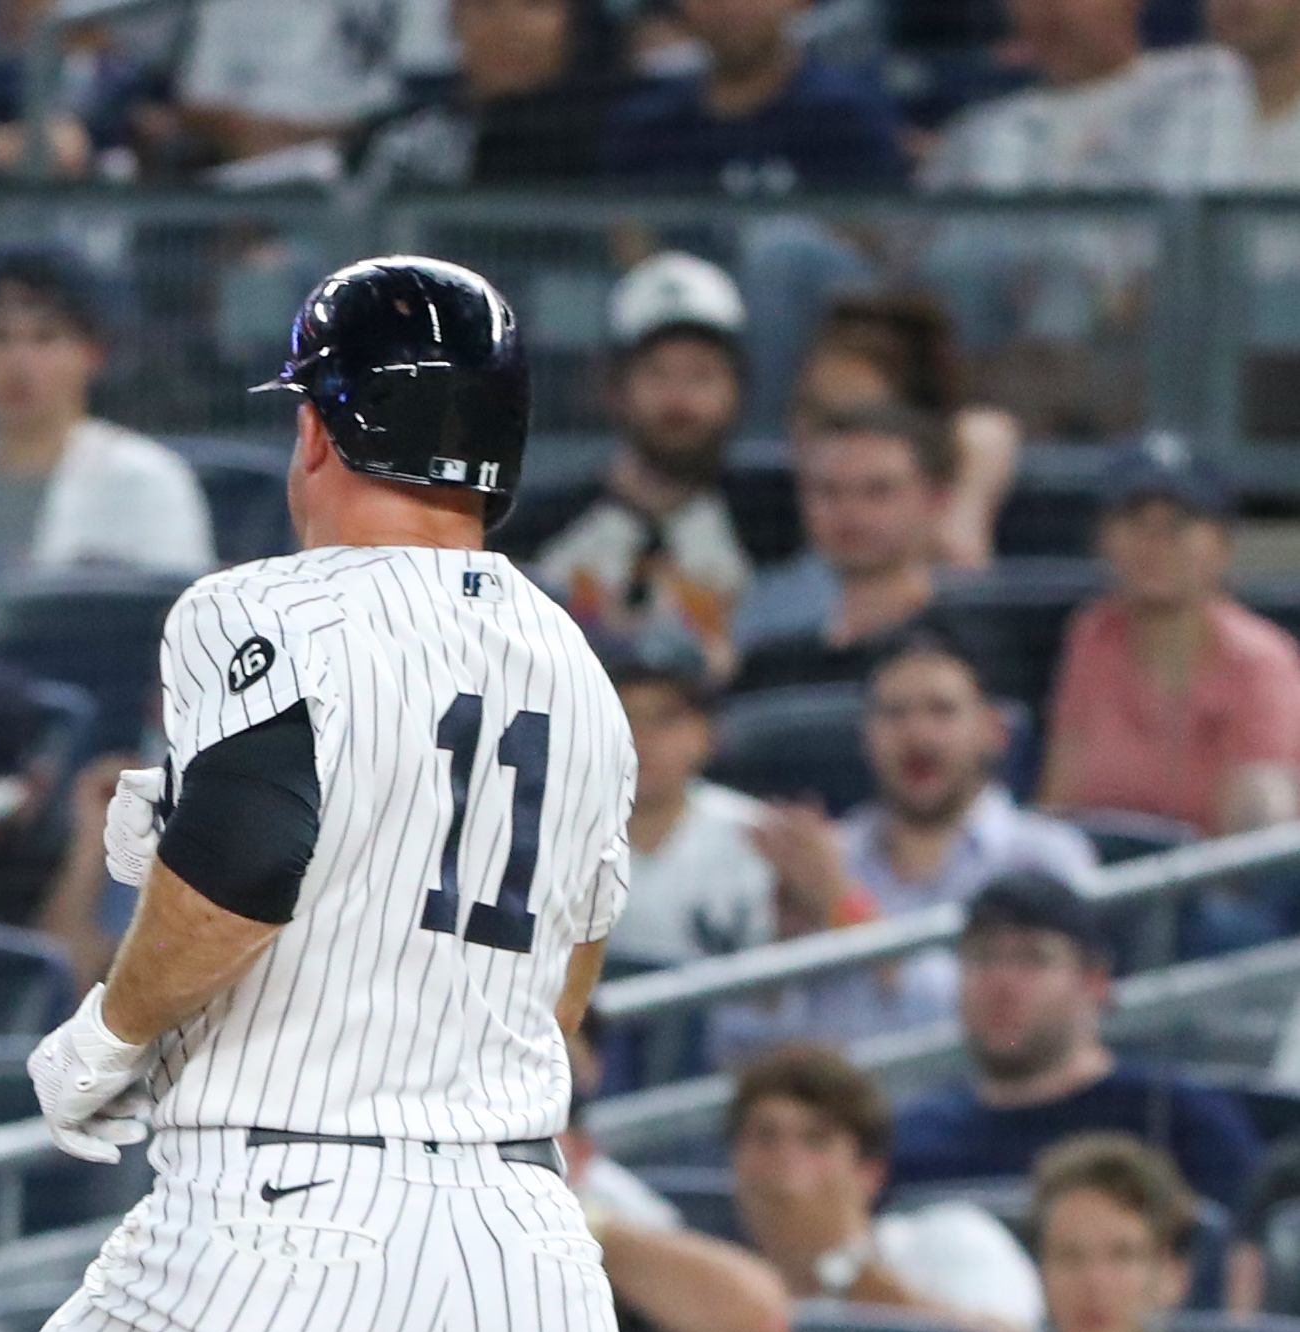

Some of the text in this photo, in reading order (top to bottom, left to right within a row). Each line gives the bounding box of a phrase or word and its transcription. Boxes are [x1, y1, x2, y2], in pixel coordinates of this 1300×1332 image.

[479, 460, 500, 488] 11
[231, 642, 267, 689] 16
[419, 691, 551, 954] 11
